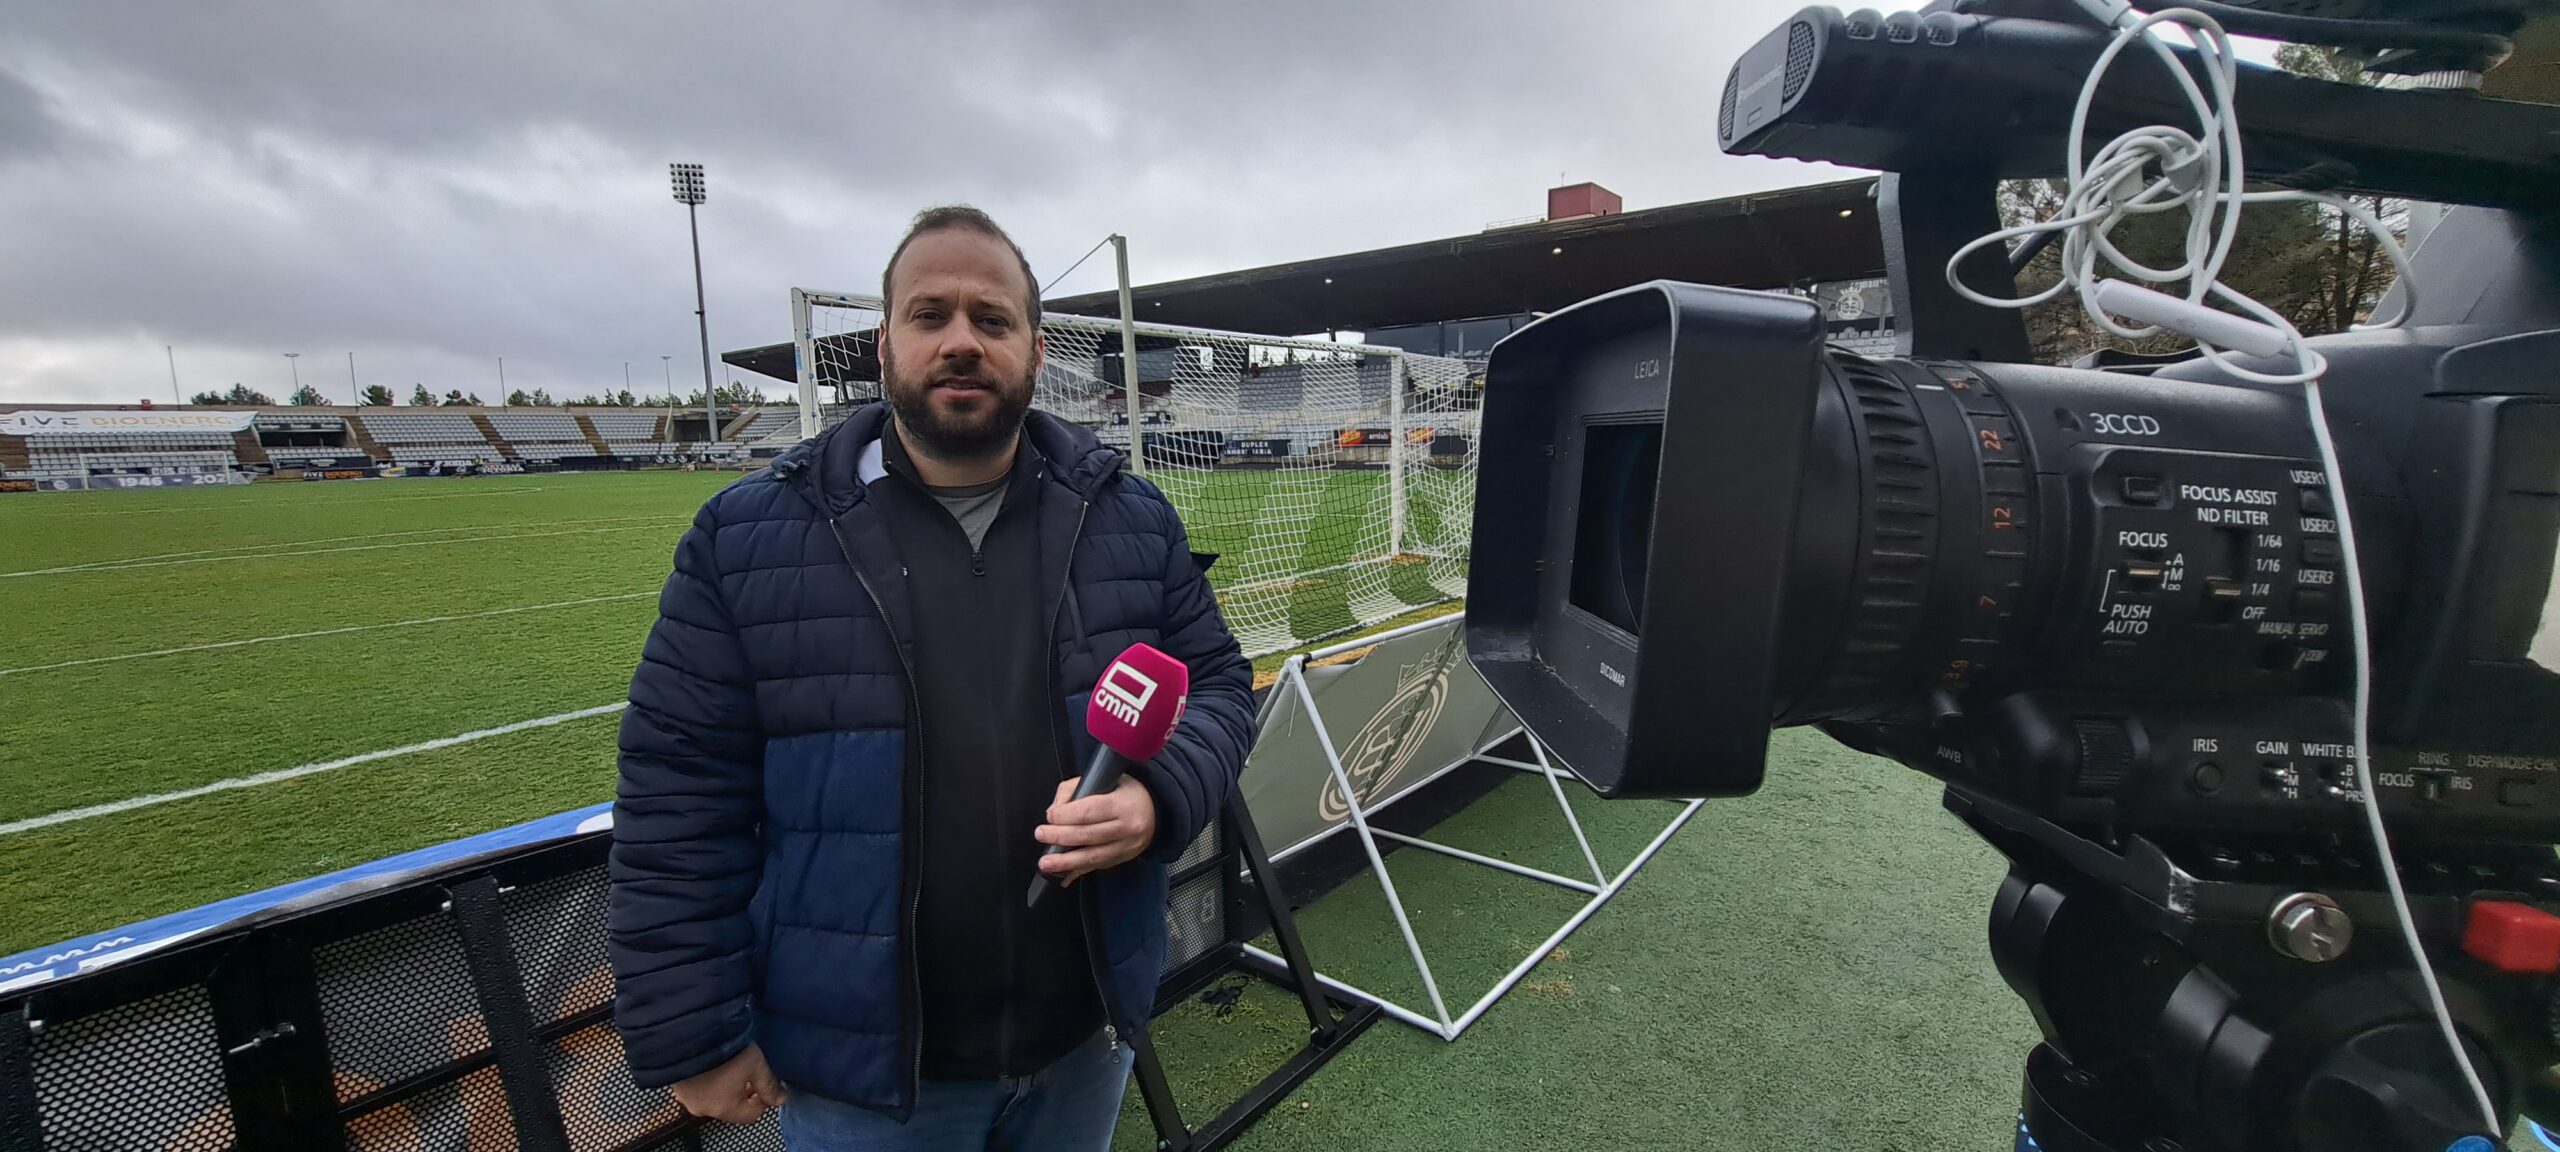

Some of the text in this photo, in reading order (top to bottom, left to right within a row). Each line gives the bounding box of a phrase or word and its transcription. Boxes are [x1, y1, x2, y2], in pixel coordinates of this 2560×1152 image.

[1634, 358, 1660, 379] LEICA
[2090, 412, 2160, 435] 3CCD
[117, 477, 163, 487] 1946
[192, 473, 227, 485] 202
[2290, 468, 2326, 485] USER1
[2181, 485, 2278, 506] FOCUS ASSIST
[1992, 506, 2012, 530] 12
[2197, 507, 2269, 526] ND FILTER
[2301, 517, 2337, 534] USER2
[2118, 531, 2169, 549] FOCUS
[2257, 533, 2283, 549] 1/64
[2173, 553, 2185, 567] A
[2255, 557, 2281, 573] 1/16
[2170, 568, 2184, 582] M
[2298, 568, 2335, 585] USER3
[2250, 582, 2271, 597] 1/4
[2110, 603, 2153, 619] PUSH
[2242, 606, 2267, 620] OFF
[2102, 620, 2149, 635] AUTO
[1095, 688, 1140, 728] cmm
[2192, 738, 2219, 753] IRIS
[2255, 740, 2289, 755] GAIN
[2302, 742, 2342, 758] WHITE
[1937, 745, 1962, 764] AWB
[2418, 751, 2450, 766] RING
[2378, 772, 2416, 788] FOCUS
[2450, 776, 2473, 791] IRIS
[2345, 790, 2367, 803] PRS
